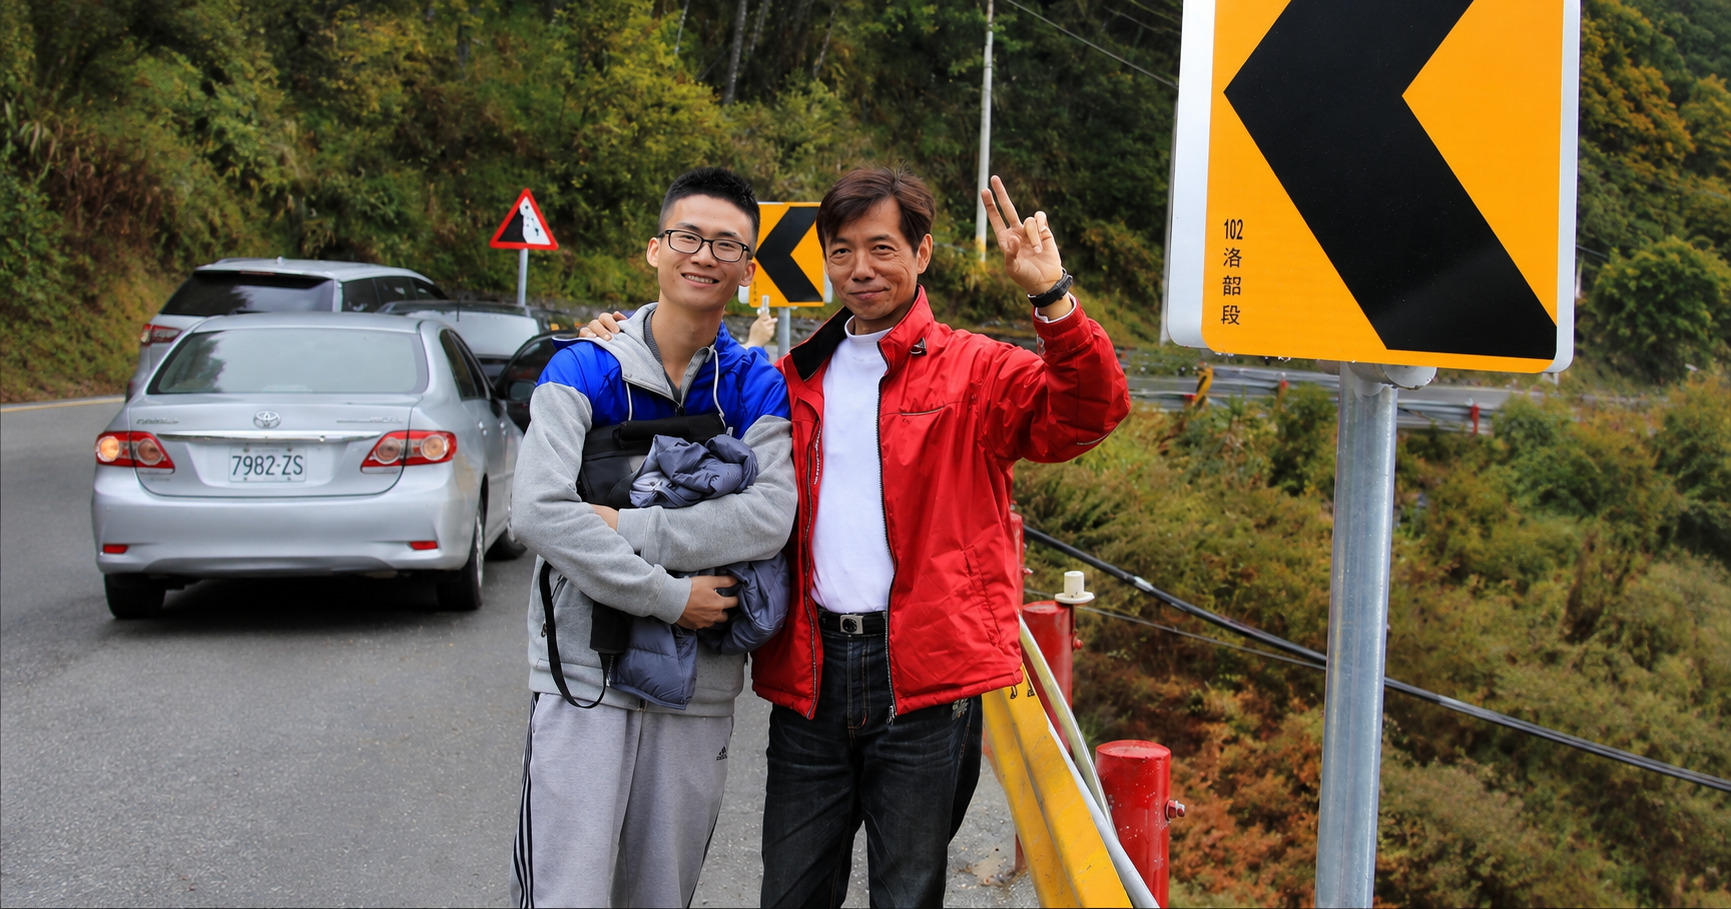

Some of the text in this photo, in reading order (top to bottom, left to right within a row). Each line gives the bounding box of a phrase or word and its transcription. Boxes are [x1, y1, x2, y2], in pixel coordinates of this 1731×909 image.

[1224, 218, 1243, 240] 102
[1221, 247, 1242, 325] 洛韶段
[232, 455, 303, 476] 7982-ZS
